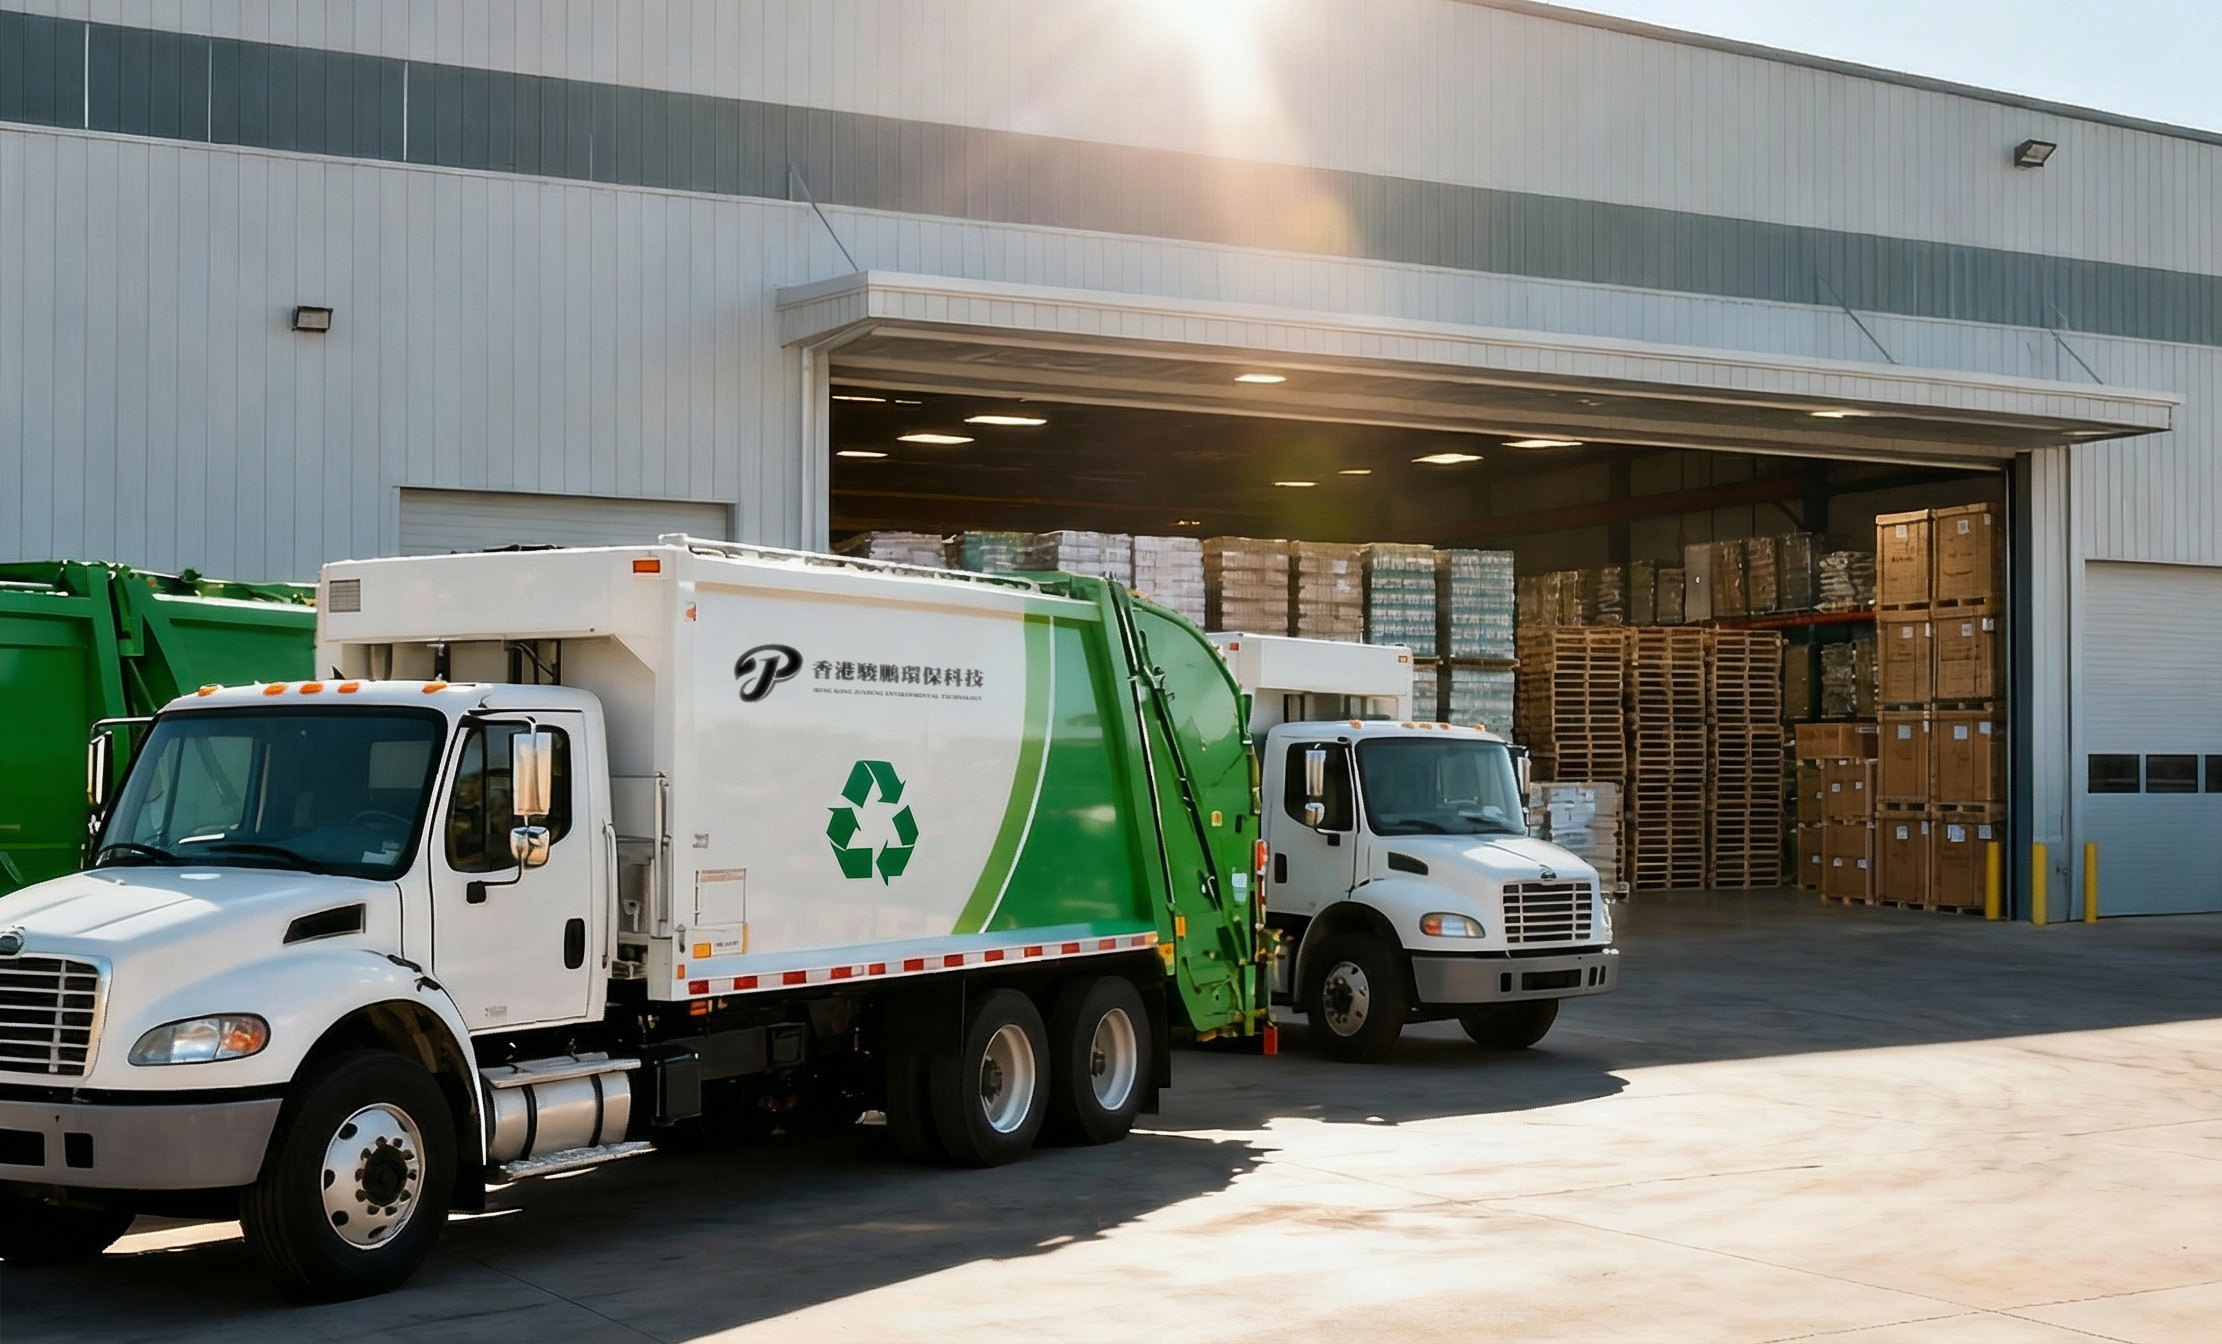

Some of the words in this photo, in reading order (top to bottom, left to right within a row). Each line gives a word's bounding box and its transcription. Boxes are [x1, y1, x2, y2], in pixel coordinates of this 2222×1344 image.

[812, 660, 984, 687] 香港駿鵬環保科技
[885, 691, 939, 699] ENVIRONMENTAL
[941, 693, 982, 701] TECHNOLOGY
